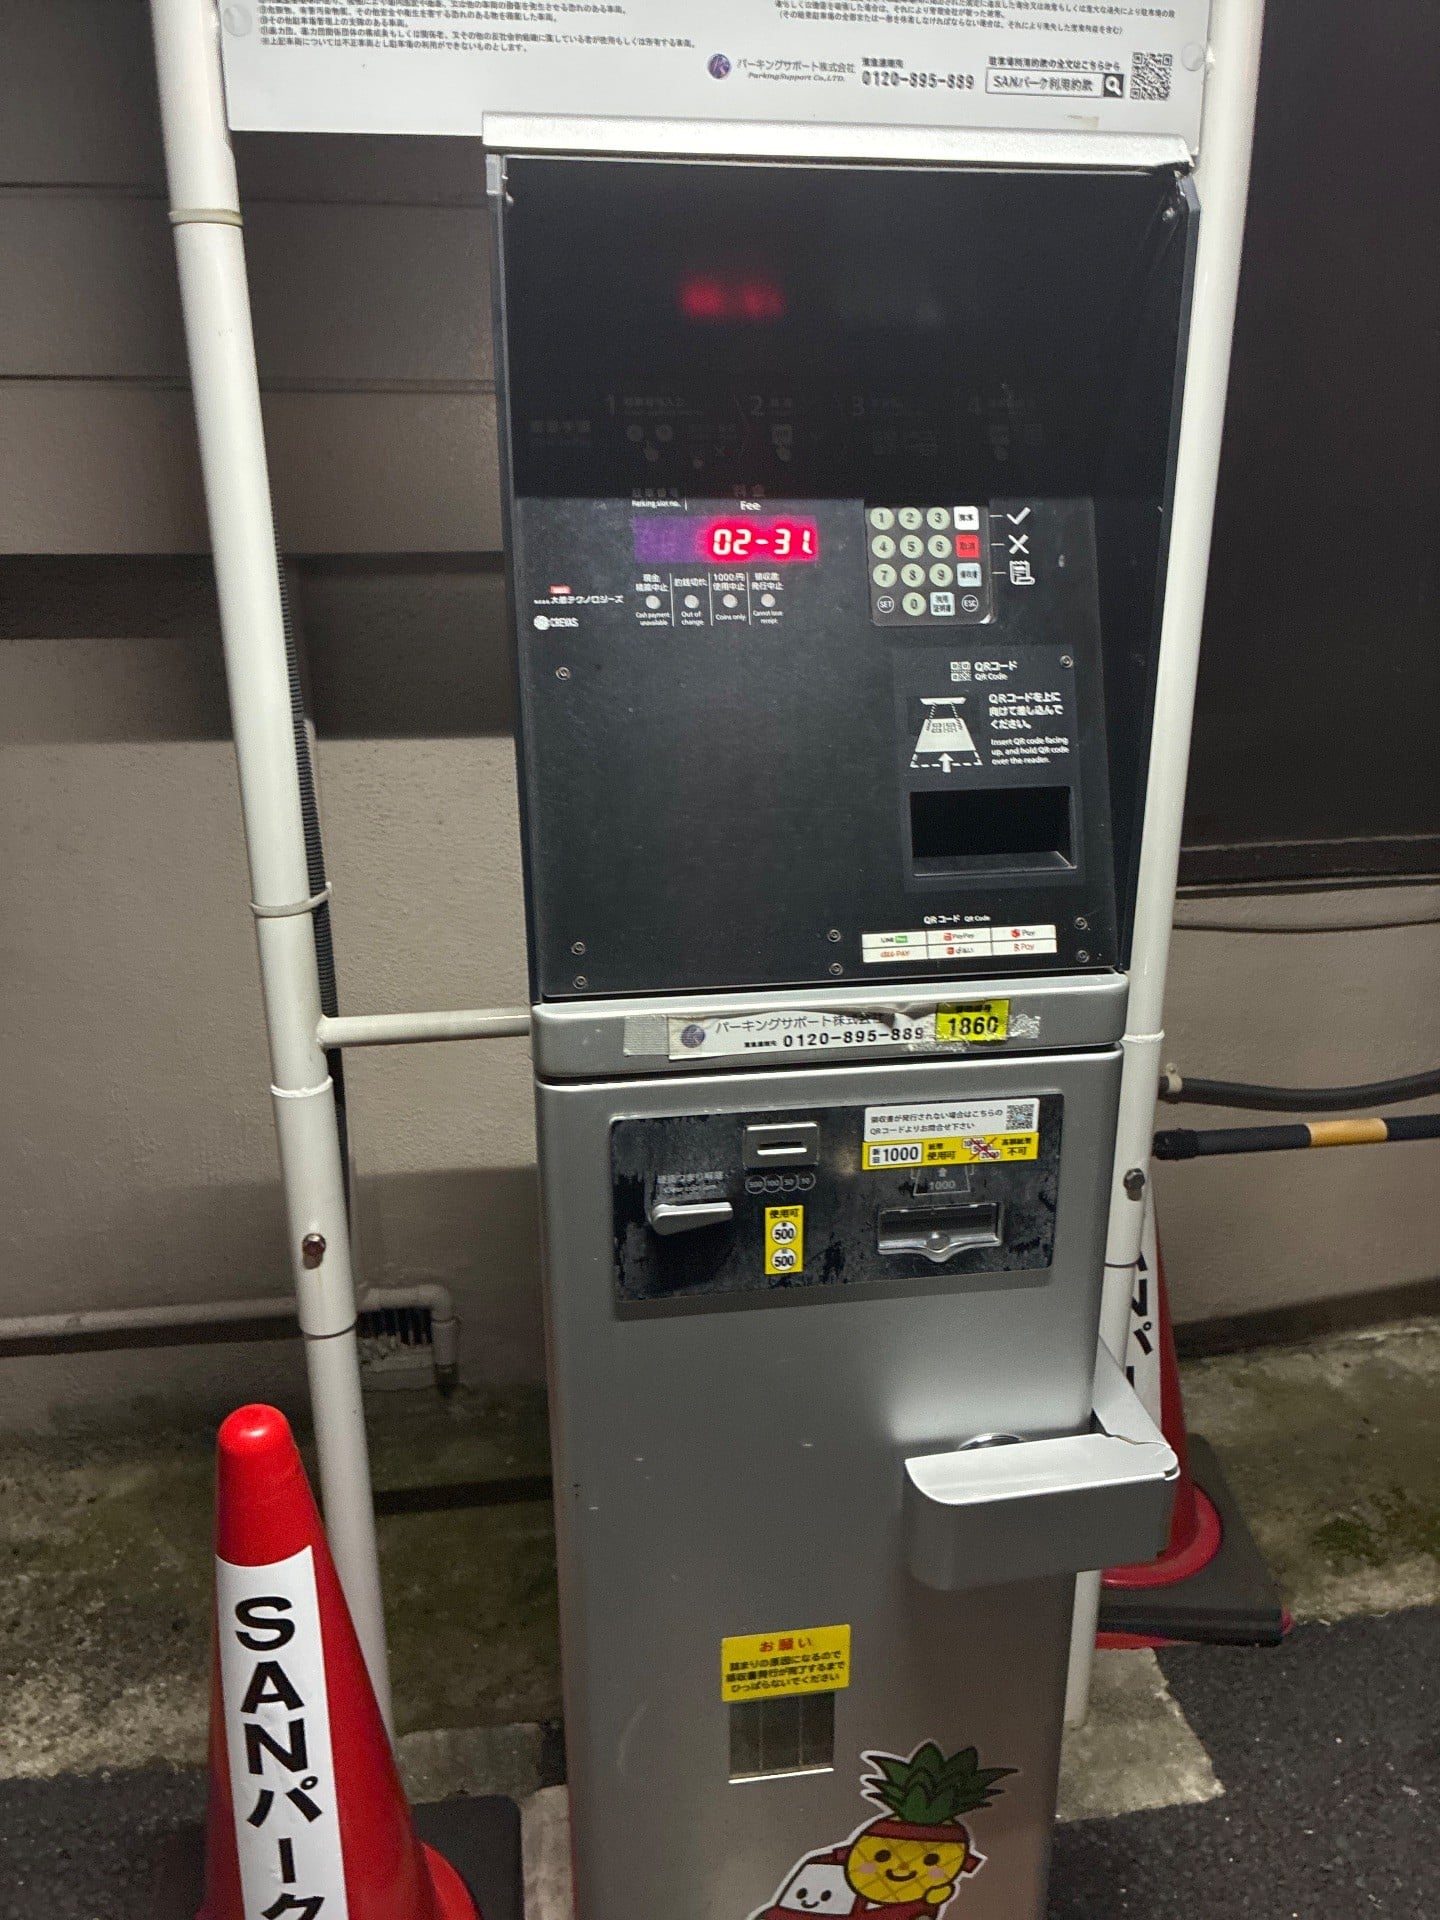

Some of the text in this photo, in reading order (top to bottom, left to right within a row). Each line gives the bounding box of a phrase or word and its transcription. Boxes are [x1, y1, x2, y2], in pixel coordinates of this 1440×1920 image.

[736, 58, 857, 73] パーキングサポート株式会社
[861, 70, 975, 91] 0120-895-889
[993, 74, 1094, 92] SANパーク利用約款
[740, 500, 762, 511] Fee
[878, 512, 886, 523] 1
[906, 512, 915, 523] 2
[934, 512, 942, 523] 3
[712, 528, 814, 555] 02-31
[879, 541, 888, 552] 4
[907, 541, 916, 552] 5
[935, 541, 944, 552] 6
[642, 573, 660, 584] 現金
[713, 572, 746, 583] 1000円
[880, 570, 889, 581] 7
[908, 569, 917, 581] 8
[937, 569, 946, 580] 9
[712, 582, 747, 592] 使用中止
[751, 581, 784, 592] 発行中止
[879, 600, 892, 608] SET
[910, 598, 918, 610] 0
[963, 599, 978, 608] ESC
[635, 611, 670, 620] Cash payment
[681, 610, 702, 618] Out of
[715, 613, 733, 621] Coins
[752, 609, 771, 617] Cannot
[973, 660, 1018, 673] QRコード
[974, 672, 1009, 682] QR Code
[988, 691, 1062, 705] QRコードを上に
[988, 703, 1065, 718] 向けて差し込んで
[990, 736, 1070, 746] Insert QR code facing
[1004, 747, 1020, 756] and
[1020, 746, 1038, 755] hold
[1038, 746, 1051, 755] QR
[1050, 745, 1070, 754] code
[991, 758, 1010, 766] over
[1009, 756, 1024, 765] the
[923, 914, 960, 925] QRコード
[974, 914, 992, 922] Code
[948, 1016, 999, 1036] 1860
[782, 1026, 925, 1048] 0120-895-889
[870, 1109, 1004, 1124] 領収書が発行されない場合はこちらの
[870, 1122, 976, 1136] QRコードよりお問合せ下さい
[883, 1146, 919, 1162] 1000
[928, 1150, 957, 1161] 使用可
[1006, 1146, 1028, 1157] 不可
[928, 1180, 957, 1191] 1000
[769, 1208, 800, 1219] 使用可
[774, 1228, 795, 1241] 500
[774, 1255, 795, 1268] 500
[760, 1637, 813, 1653] お願い
[731, 1673, 840, 1693] ひっぱらないでください
